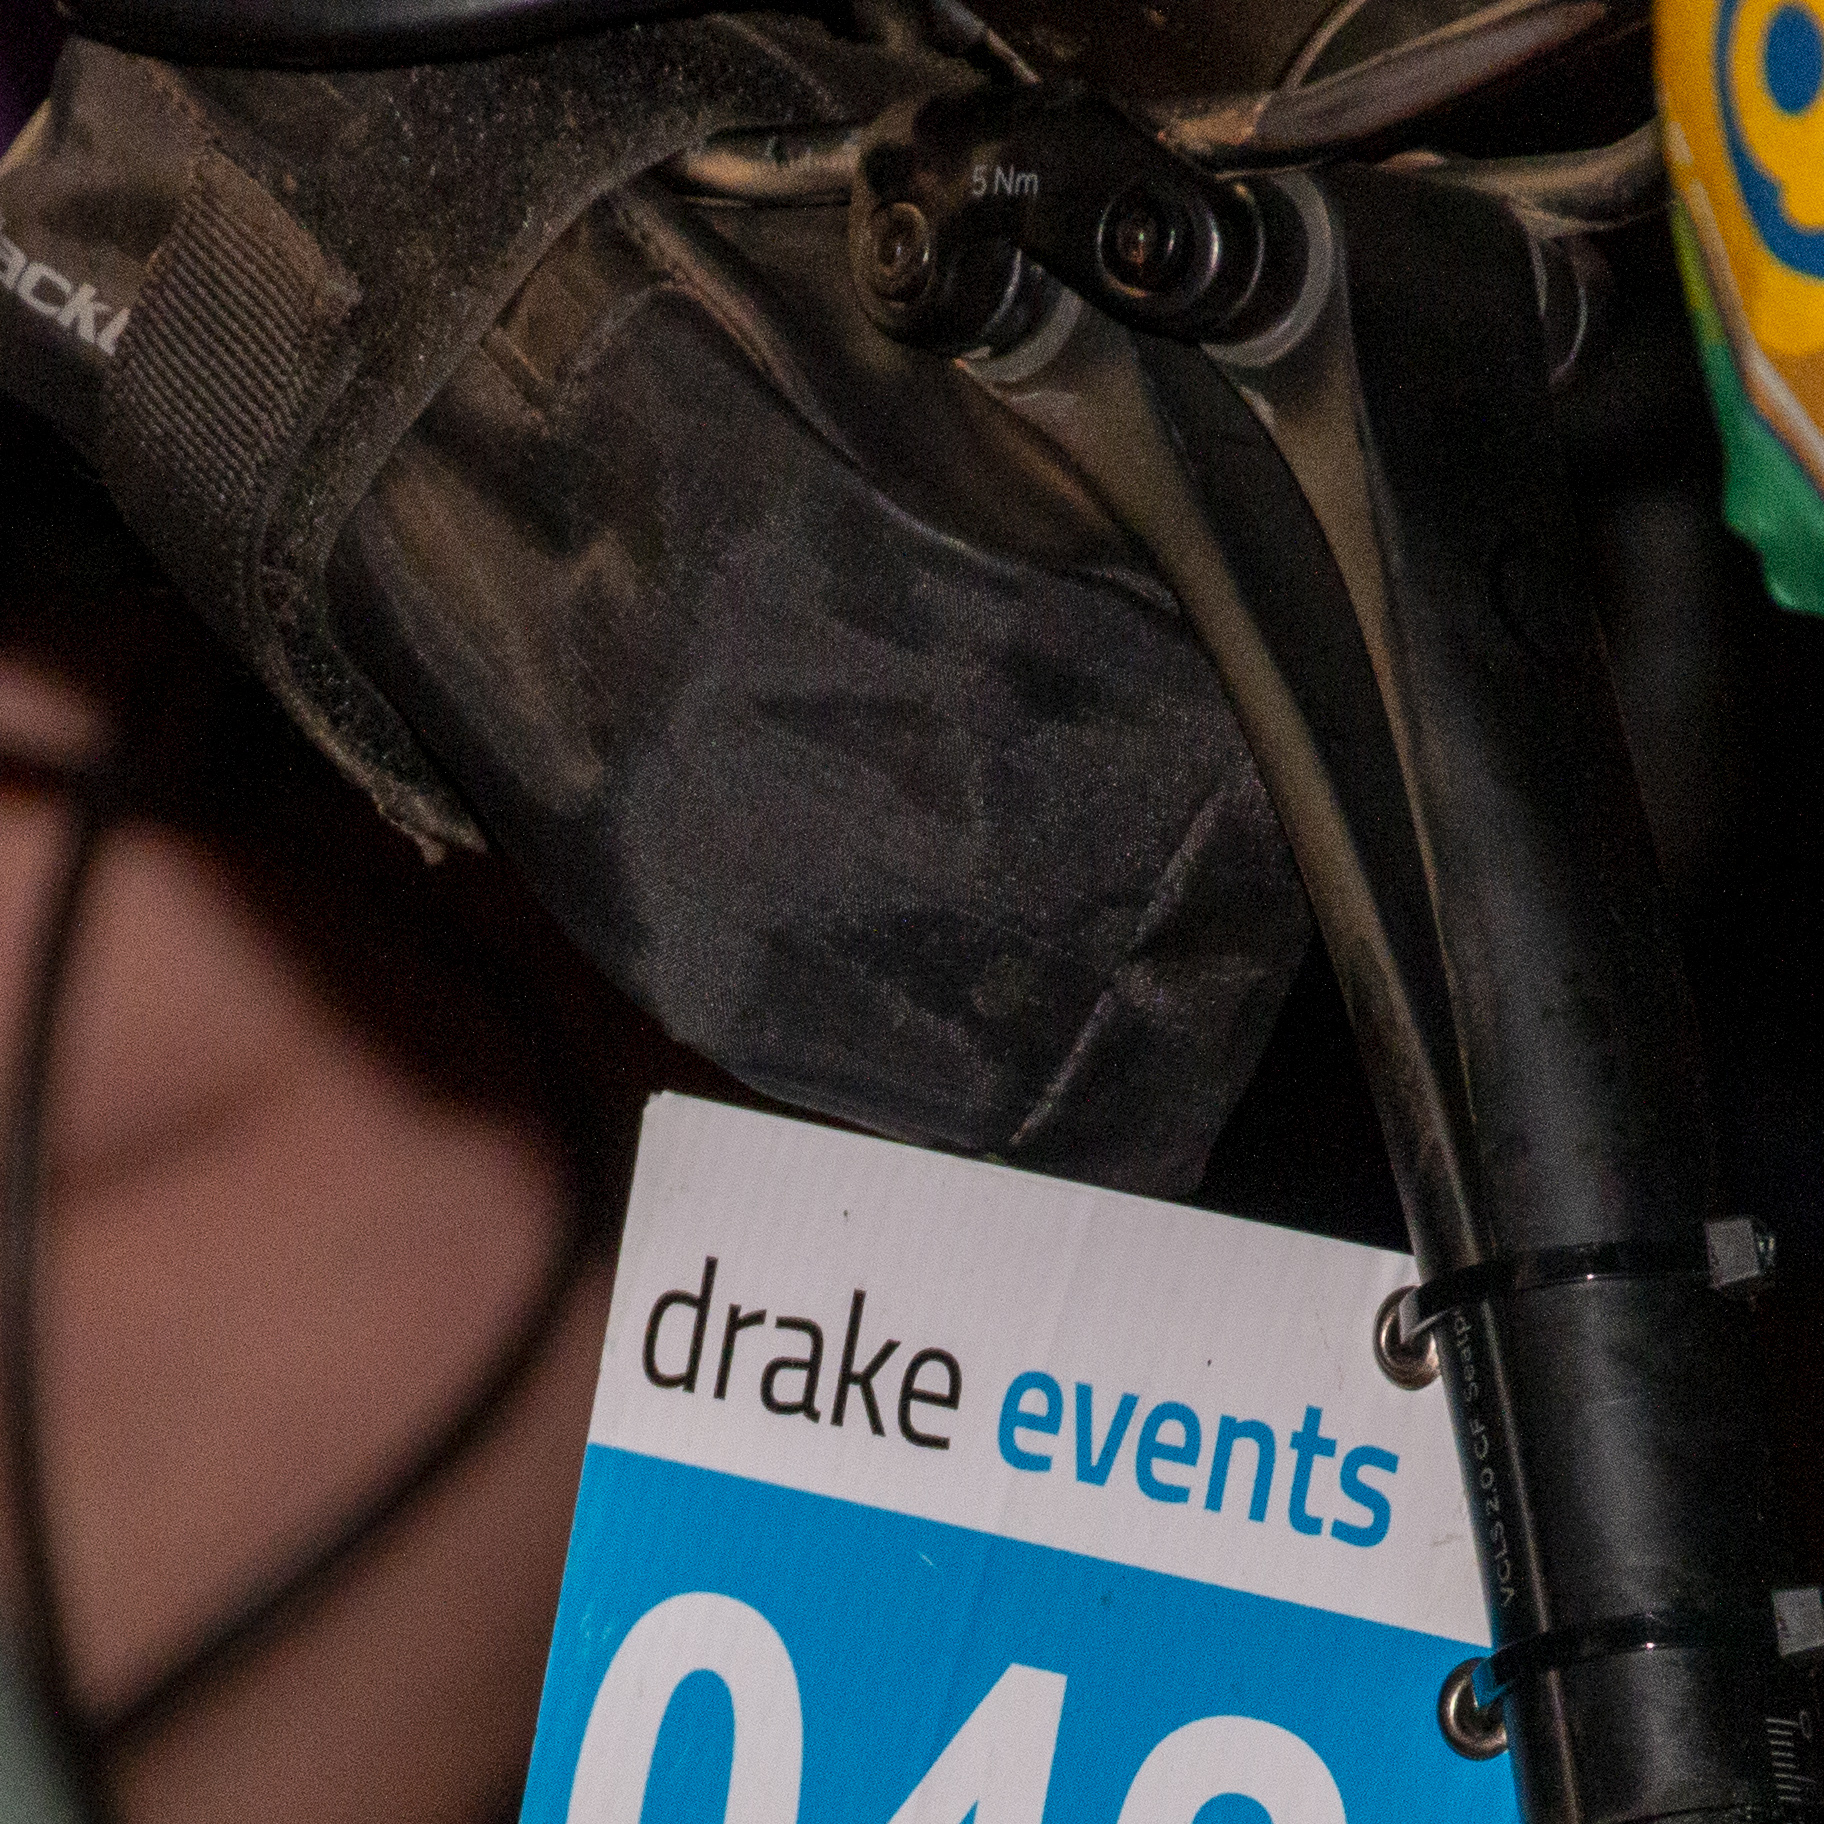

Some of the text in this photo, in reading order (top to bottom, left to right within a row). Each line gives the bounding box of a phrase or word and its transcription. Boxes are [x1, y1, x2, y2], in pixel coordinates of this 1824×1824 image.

[972, 163, 1039, 197] 5 Nm
[640, 1255, 1401, 1549] drake events
[1468, 1418, 1490, 1461] CF
[1480, 1466, 1501, 1517] 2.0
[1489, 1520, 1516, 1608] VCLS
